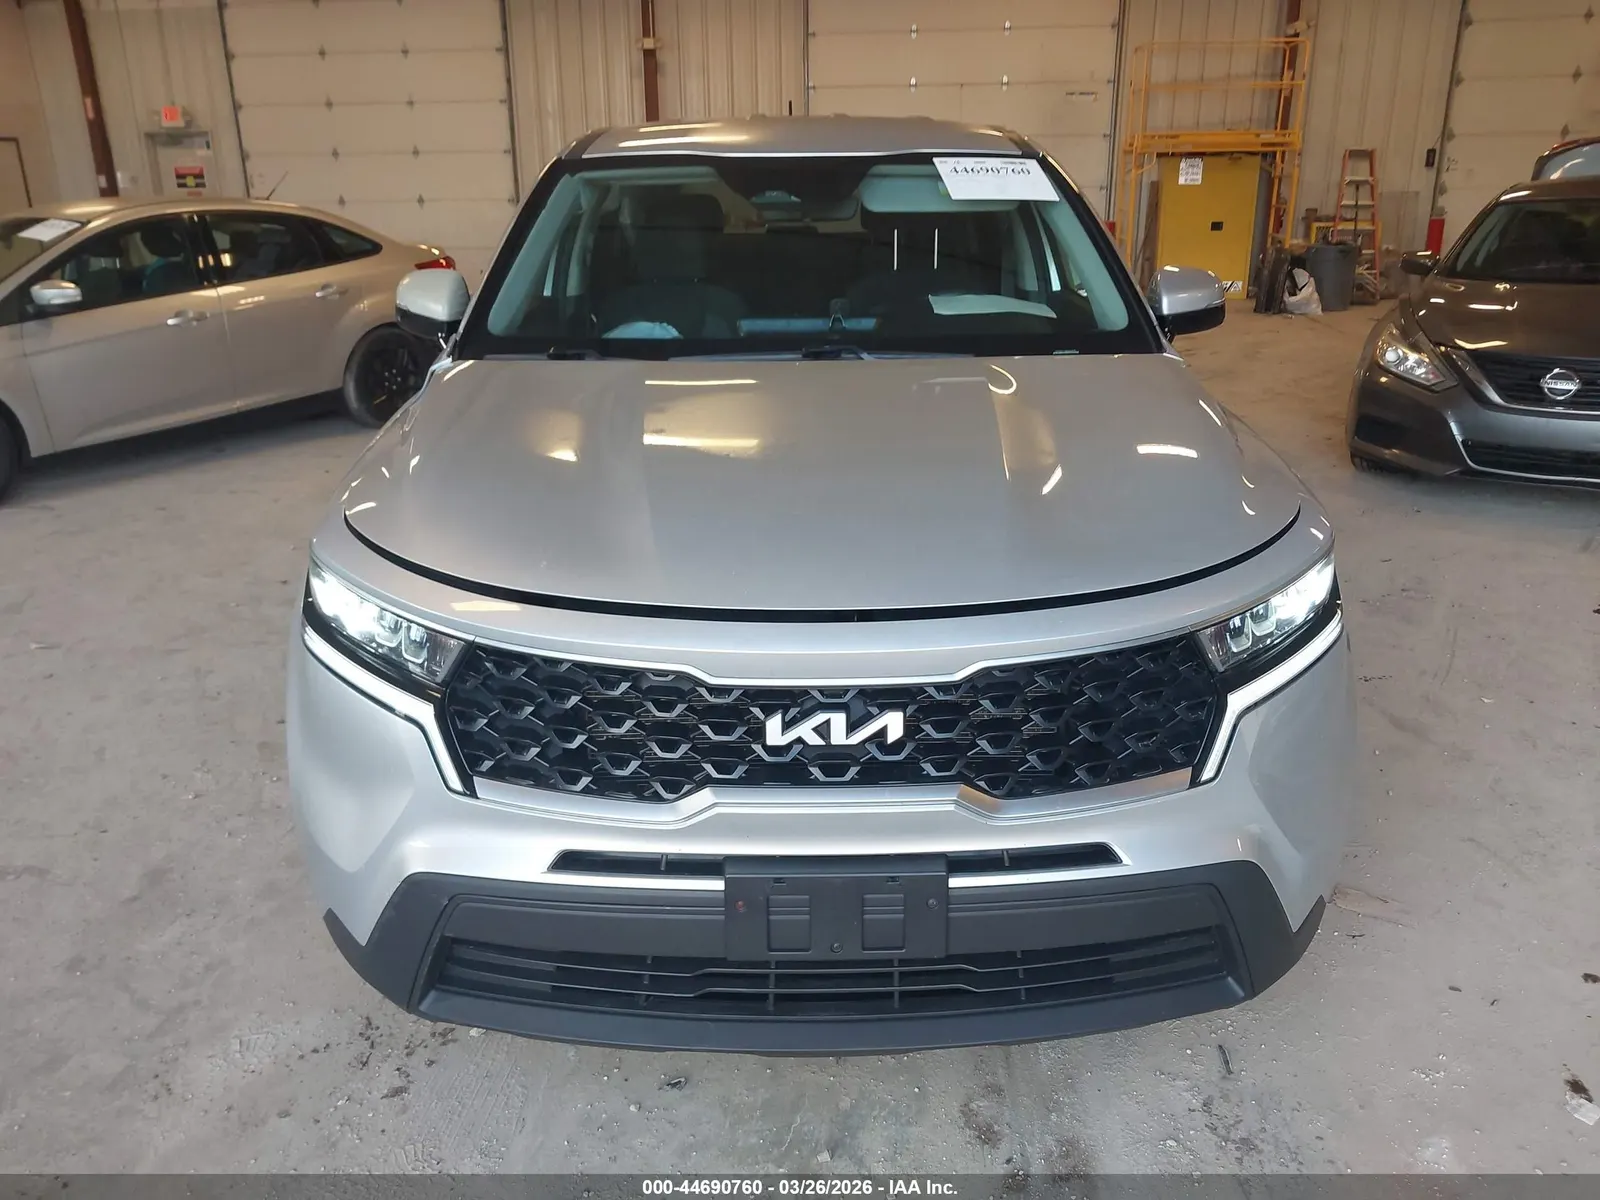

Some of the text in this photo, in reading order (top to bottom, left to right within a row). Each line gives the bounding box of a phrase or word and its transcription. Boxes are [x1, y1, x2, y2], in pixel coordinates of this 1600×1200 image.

[950, 165, 1031, 176] 44690760
[1544, 380, 1577, 388] NISSAN
[765, 709, 904, 746] KIA
